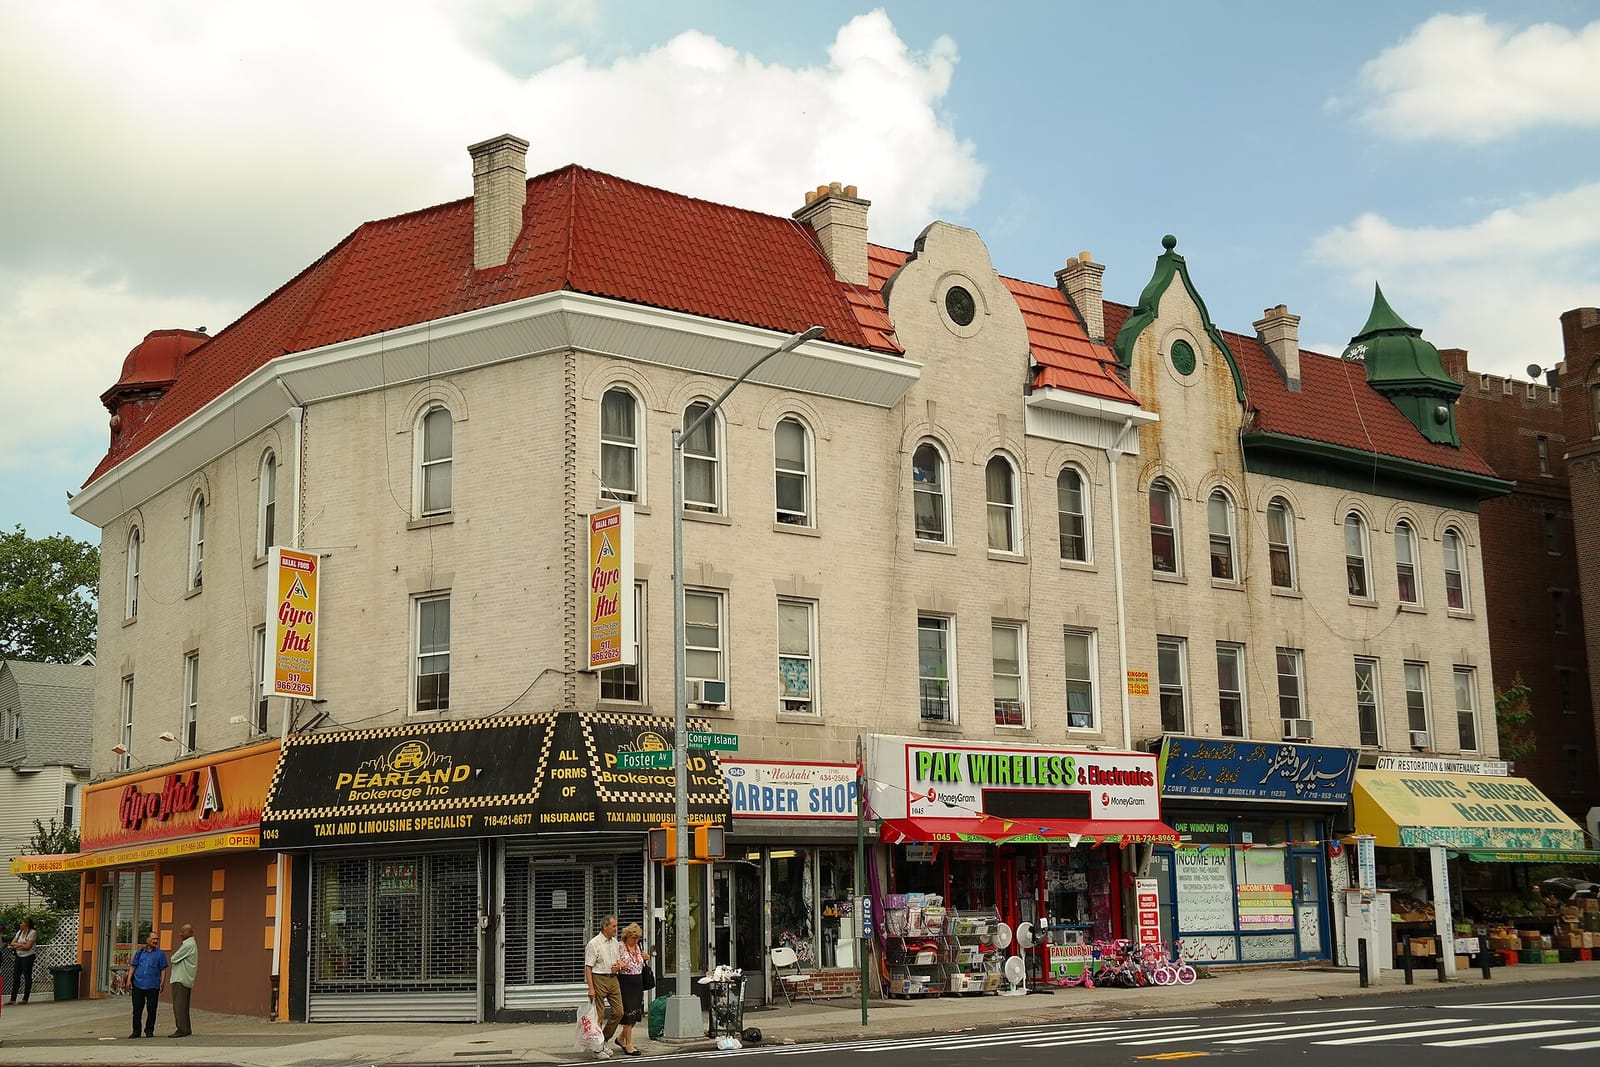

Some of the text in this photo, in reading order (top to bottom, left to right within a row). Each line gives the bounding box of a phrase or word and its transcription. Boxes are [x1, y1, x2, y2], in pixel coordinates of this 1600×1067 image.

[592, 567, 619, 593] Gyro
[594, 593, 618, 622] Hut
[279, 602, 313, 628] Gyro
[280, 630, 311, 653] Hut
[601, 640, 610, 650] 917
[288, 673, 300, 682] 917
[689, 733, 737, 746] Coney Island
[558, 750, 578, 760] ALL
[624, 753, 655, 768] Foster
[658, 752, 667, 760] Av
[917, 751, 963, 782] PAK
[968, 754, 1076, 785] WIRELESS
[1078, 767, 1087, 784] &
[1088, 766, 1154, 786] Electronics
[1378, 758, 1395, 770] CITY
[1398, 760, 1438, 772] RESTORATION
[1439, 762, 1444, 772] &
[1444, 762, 1480, 774] MAINTENANCE
[336, 764, 471, 790] PEARLAND
[551, 768, 587, 779] FORMS
[602, 772, 718, 787] Brokerag Inc
[348, 784, 450, 802] Brokerage Inc
[562, 786, 576, 797] OF
[1400, 778, 1547, 802] FRUITS GROCERY
[158, 771, 200, 822] Hut
[808, 781, 858, 813] SHOP
[938, 793, 976, 804] MoneyGram
[1110, 796, 1145, 808] MoneyGram
[120, 784, 160, 830] Gyro
[911, 807, 924, 815] 1045
[1452, 802, 1565, 824] Halal Meat
[484, 814, 532, 826] 718-421-6677
[540, 812, 595, 823] INSURANCE
[606, 812, 624, 822] TAXI
[626, 812, 641, 822] AND
[314, 814, 472, 837] TAXI AND LIMOUSINE SPECIALIST
[1176, 824, 1228, 832] ONE WINDOW PRO
[263, 828, 279, 840] 1043
[1127, 834, 1176, 842] 718-724-8962
[228, 836, 256, 846] OPEN
[1176, 854, 1226, 866] INCOME TAX
[1240, 884, 1274, 892] INCOME TAX
[1052, 946, 1062, 956] PAY
[1064, 946, 1082, 956] YOUR
